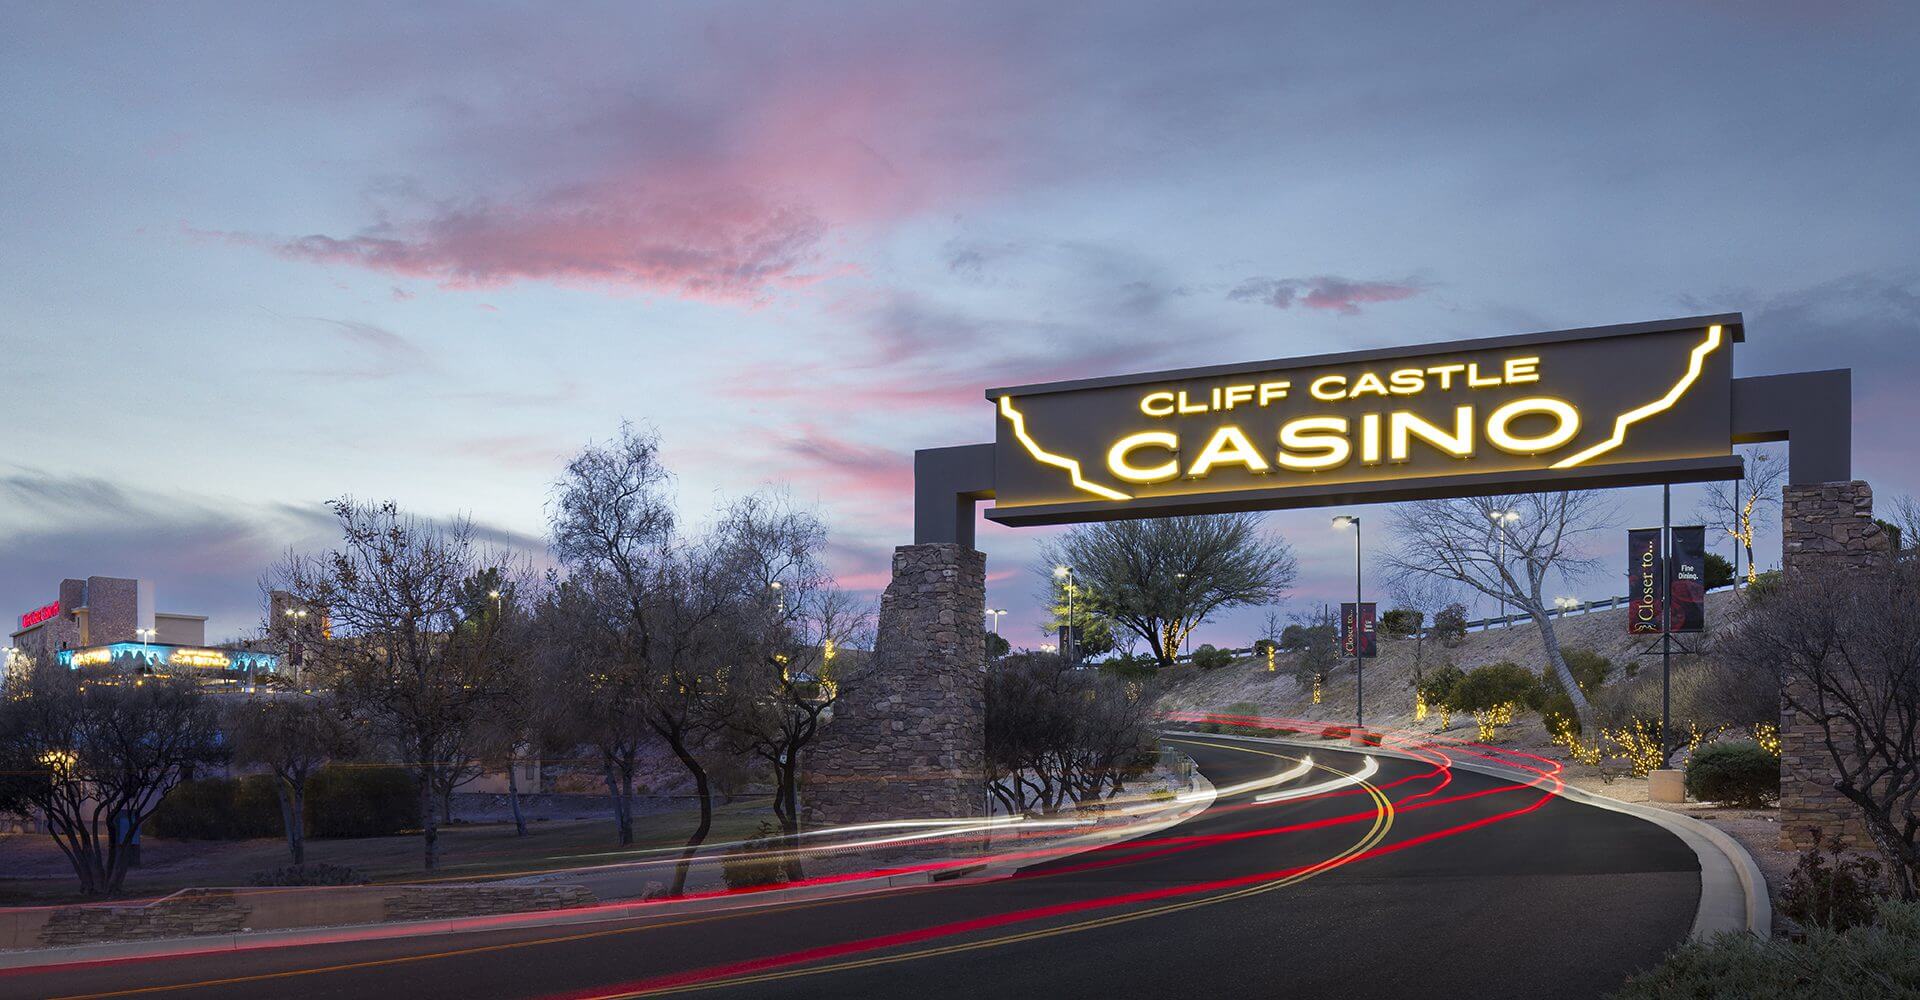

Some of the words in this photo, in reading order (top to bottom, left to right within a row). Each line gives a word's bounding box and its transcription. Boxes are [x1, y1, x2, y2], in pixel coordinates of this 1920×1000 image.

[1139, 381, 1291, 417] CLIFF
[1309, 356, 1541, 401] CASTLE
[1107, 397, 1581, 484] CASINO
[1642, 541, 1654, 568] to...
[1638, 572, 1654, 621] Closer
